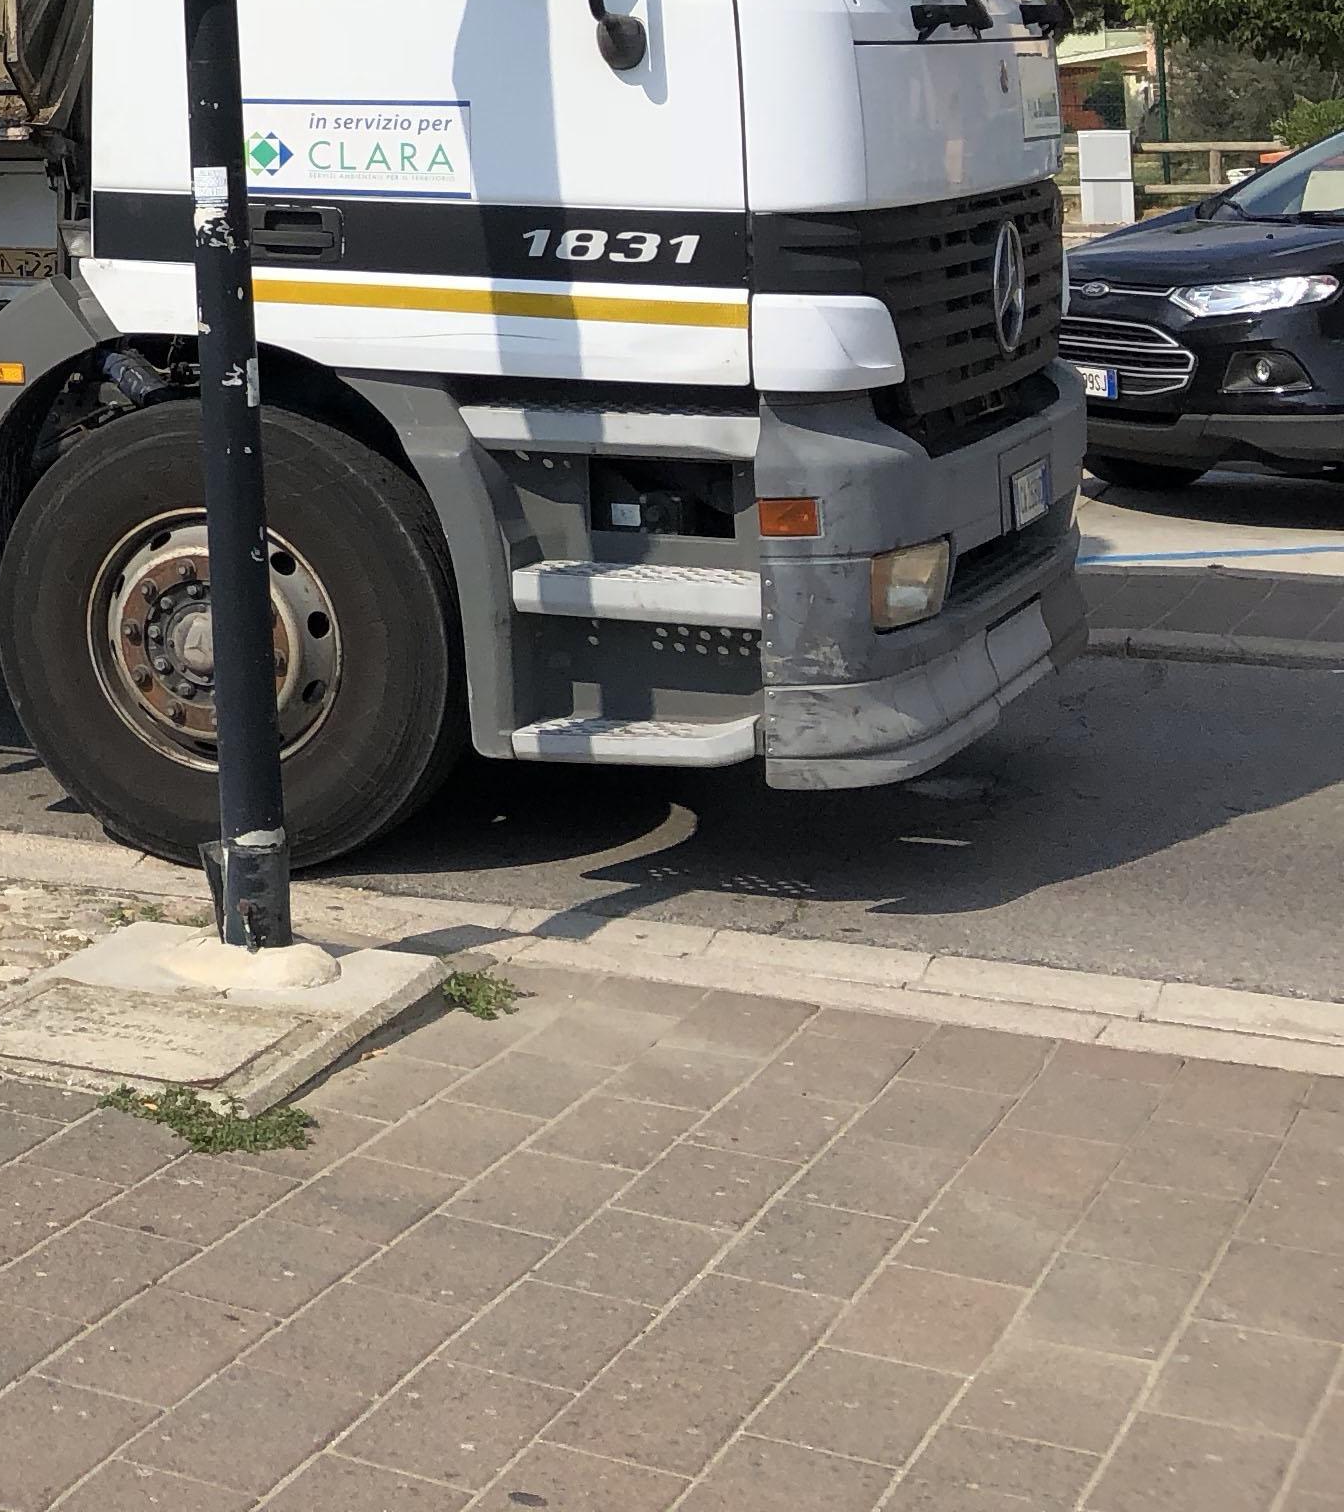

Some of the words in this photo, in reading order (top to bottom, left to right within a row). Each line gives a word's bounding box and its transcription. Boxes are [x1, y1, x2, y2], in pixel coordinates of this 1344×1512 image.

[309, 112, 328, 130] in
[333, 113, 412, 132] servizio
[417, 117, 453, 135] per
[308, 140, 455, 173] CLARA
[522, 229, 700, 264] 1831
